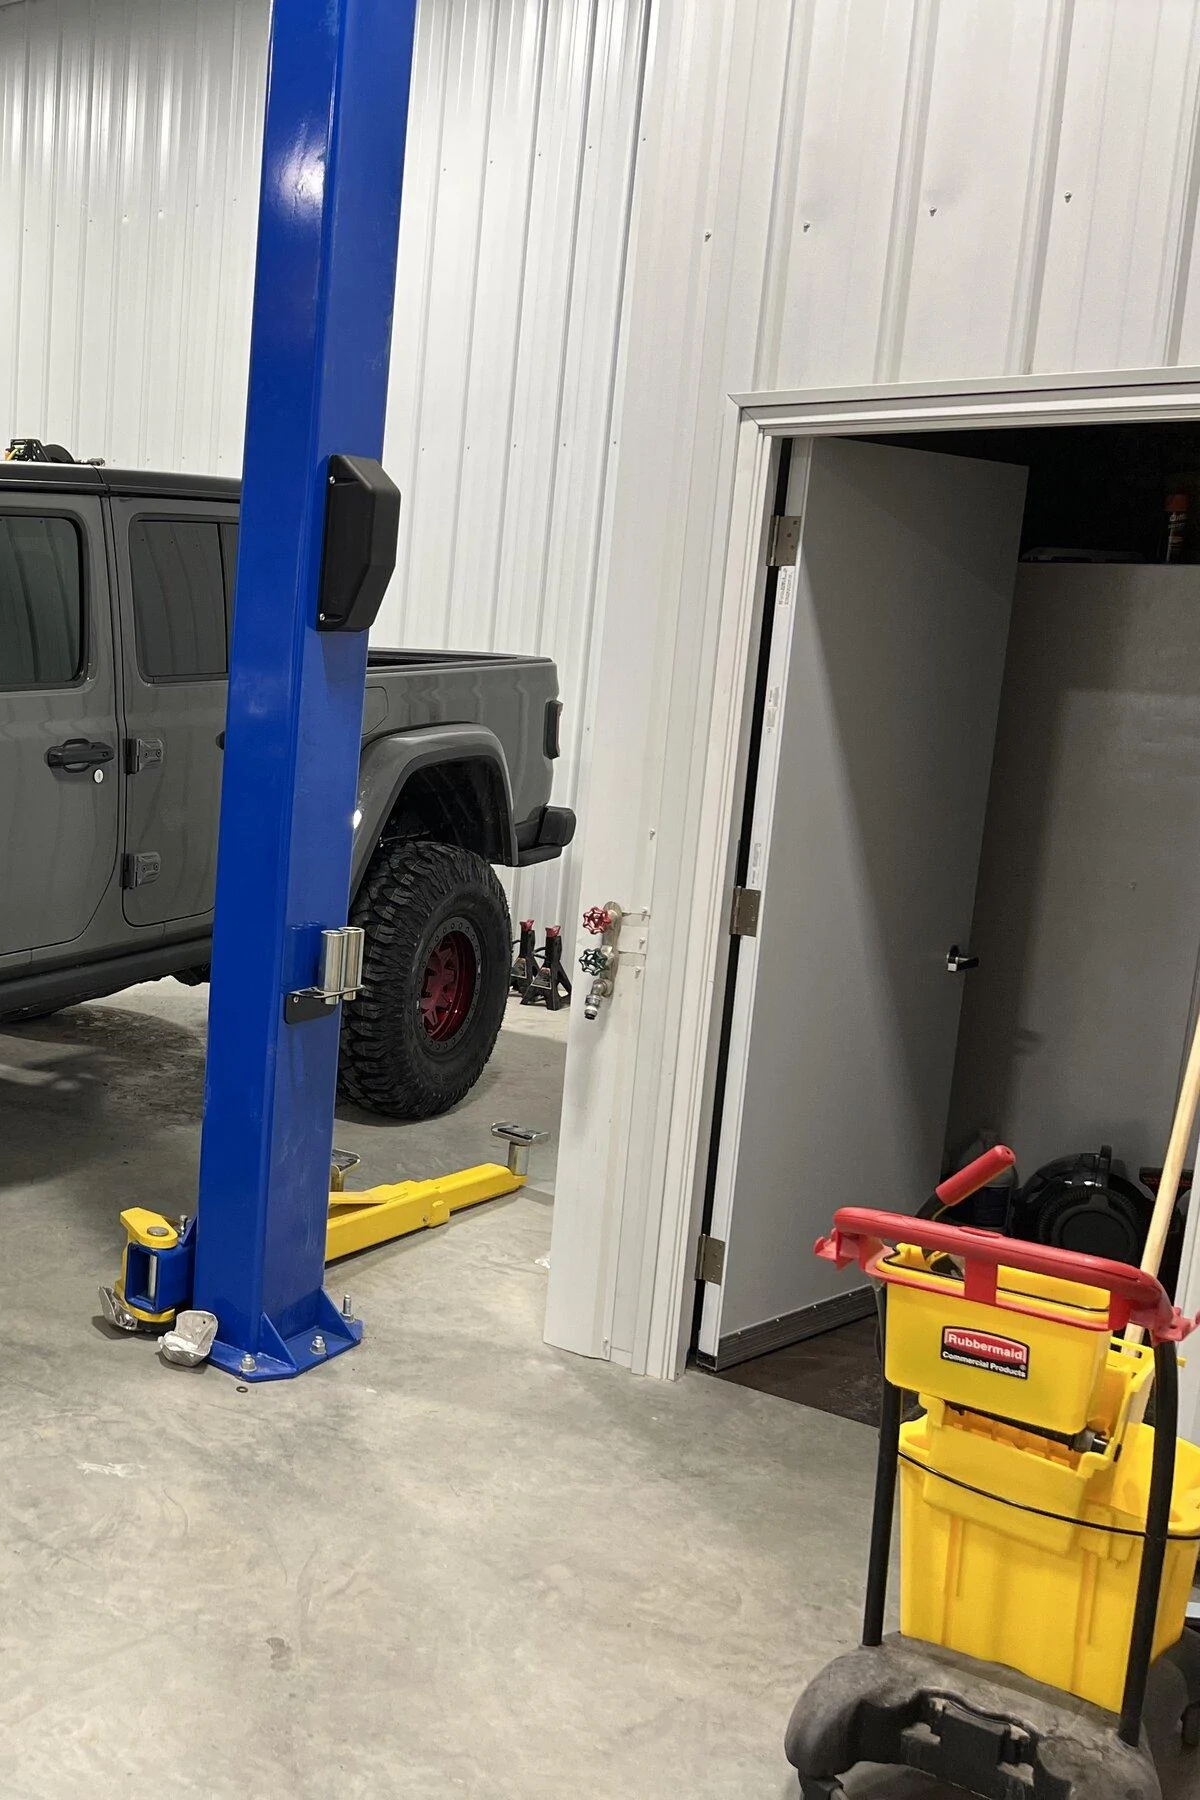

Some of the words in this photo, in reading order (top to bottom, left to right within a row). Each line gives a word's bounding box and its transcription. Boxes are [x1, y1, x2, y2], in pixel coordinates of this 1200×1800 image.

[948, 1333, 1023, 1360] Rubbermaid
[942, 1350, 990, 1369] Commercial
[989, 1362, 1026, 1378] Products
